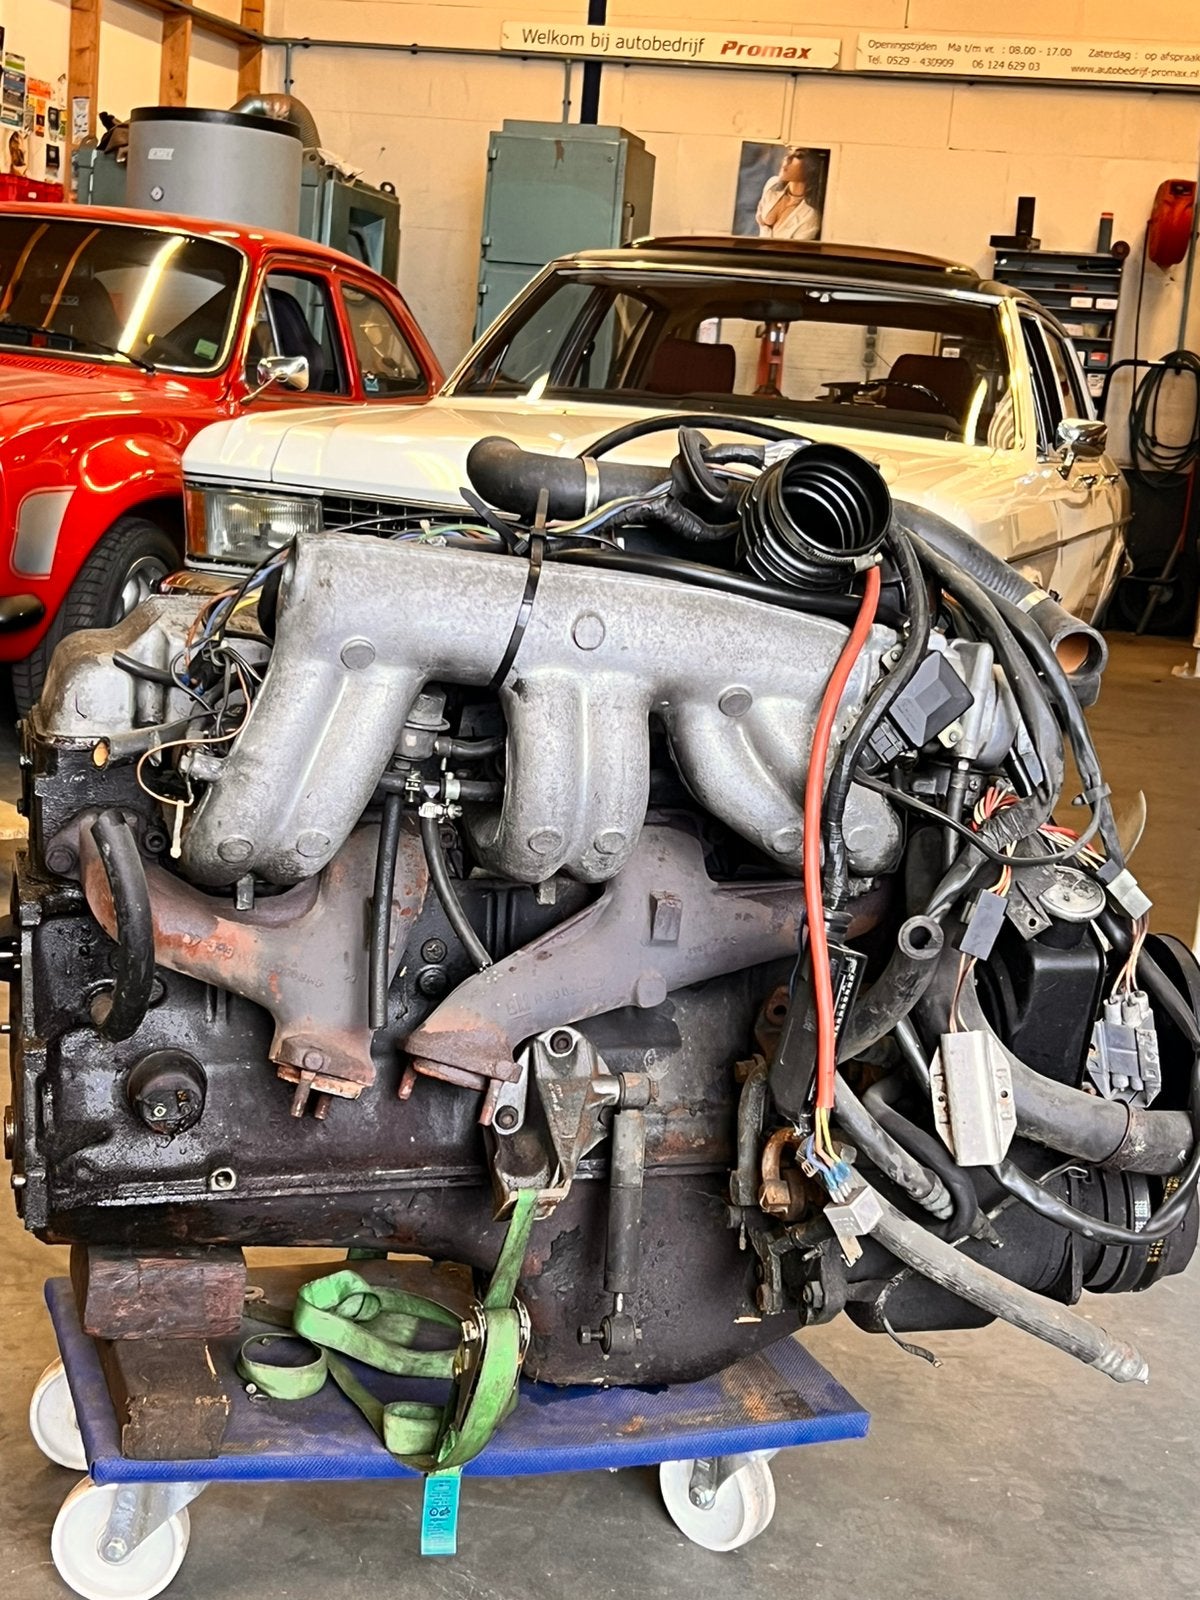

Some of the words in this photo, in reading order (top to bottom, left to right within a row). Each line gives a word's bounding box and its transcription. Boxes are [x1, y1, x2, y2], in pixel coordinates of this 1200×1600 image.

[522, 28, 585, 47] Welkom
[590, 32, 610, 52] bij
[615, 35, 706, 57] autobedrijf
[720, 40, 812, 60] Promax
[867, 39, 938, 52] Openingstijden
[947, 42, 962, 52] Ma
[964, 43, 982, 53] t/m
[1008, 45, 1036, 55] 08.00
[1046, 46, 1073, 57] 17.00
[1088, 48, 1132, 61] Zaterdag
[1144, 52, 1158, 62] op
[867, 55, 882, 65] Tel.
[886, 55, 910, 66] 0529
[919, 57, 955, 68] 430909
[971, 59, 984, 69] 06
[987, 59, 1005, 70] 124
[1007, 60, 1026, 71] 629
[1028, 61, 1041, 71] 03
